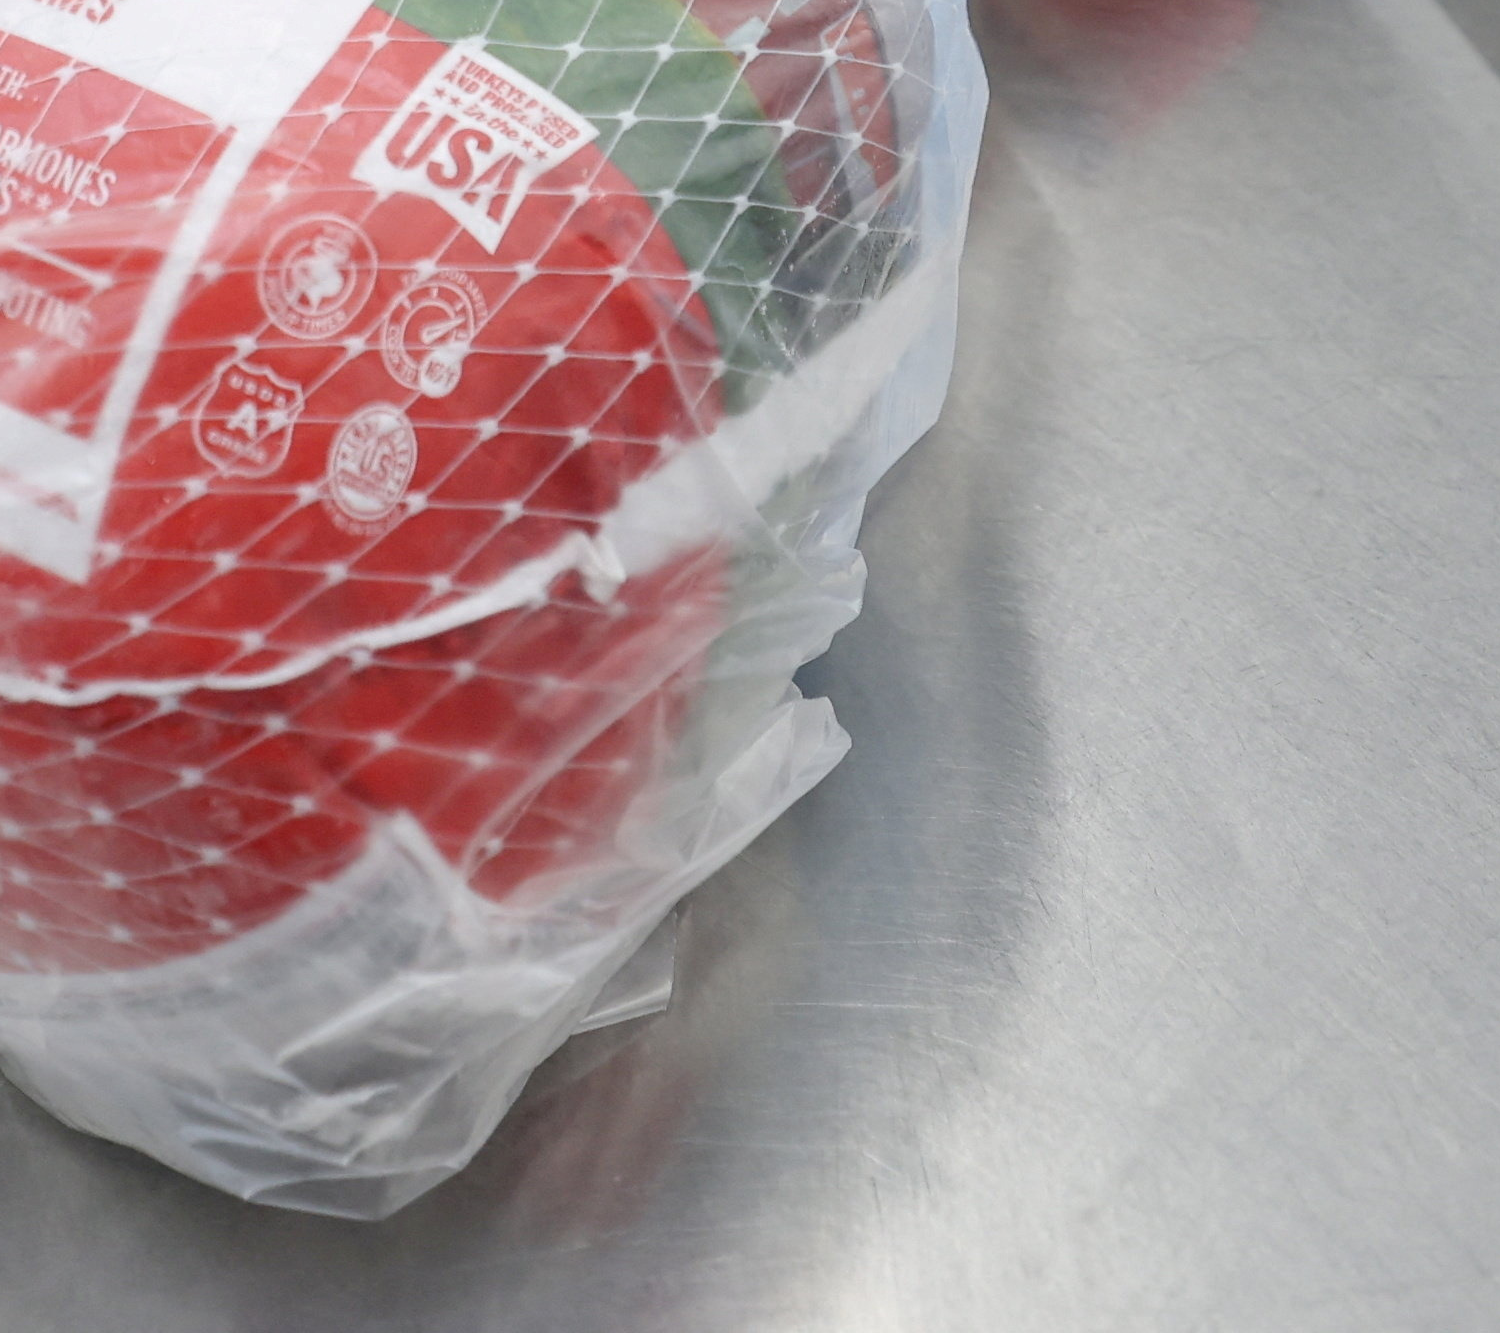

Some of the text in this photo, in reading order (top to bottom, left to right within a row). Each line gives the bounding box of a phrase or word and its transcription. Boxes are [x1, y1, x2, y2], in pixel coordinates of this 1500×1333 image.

[443, 70, 481, 95] AND
[455, 54, 529, 104] TURKEYS
[487, 114, 521, 140] the
[385, 101, 527, 225] USA
